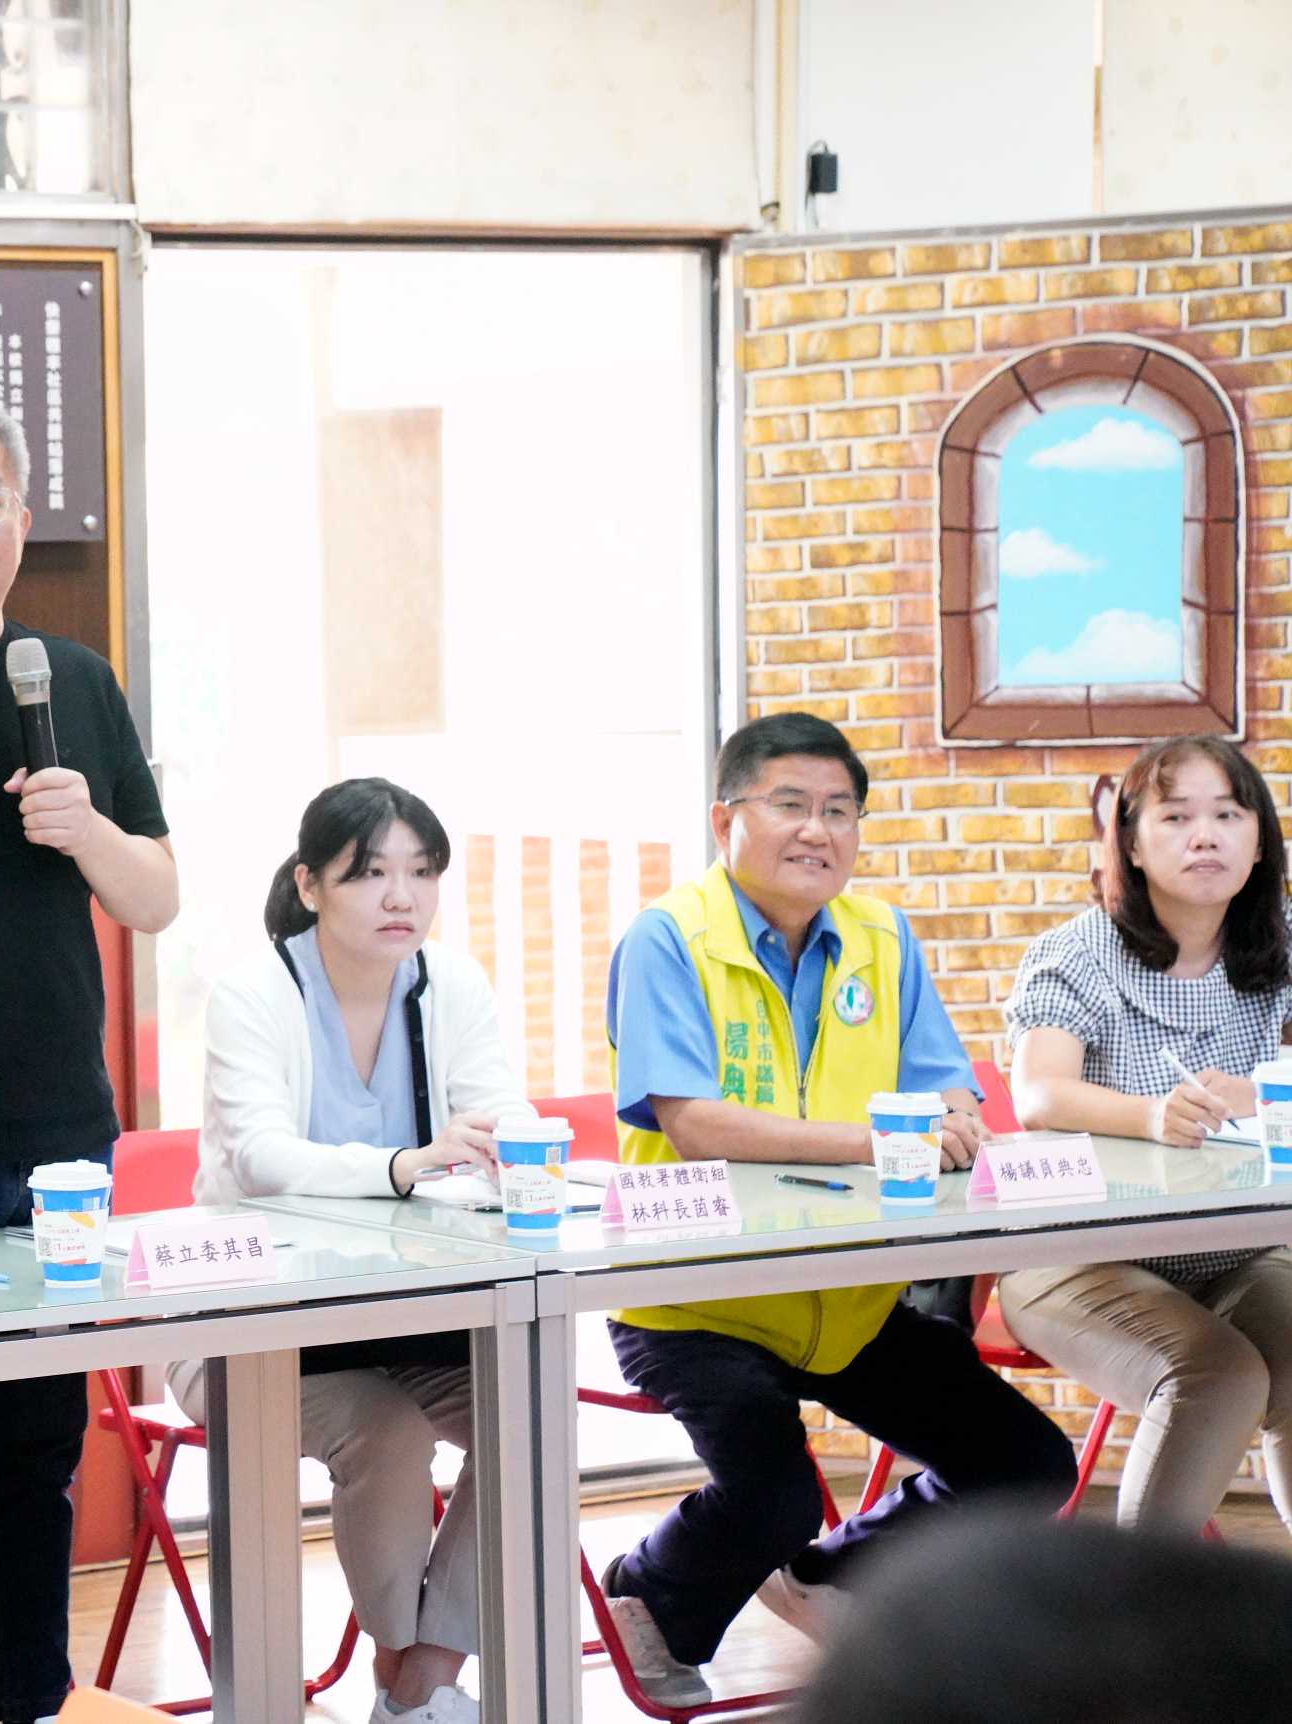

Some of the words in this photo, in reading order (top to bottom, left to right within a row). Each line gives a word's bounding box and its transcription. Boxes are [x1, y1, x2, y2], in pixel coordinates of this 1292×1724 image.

[619, 1165, 726, 1190] 國教署體衛組
[999, 1156, 1093, 1182] 楊議員典忠
[631, 1195, 731, 1223] 林科長茵睿
[155, 1236, 264, 1268] 蔡立委其昌
